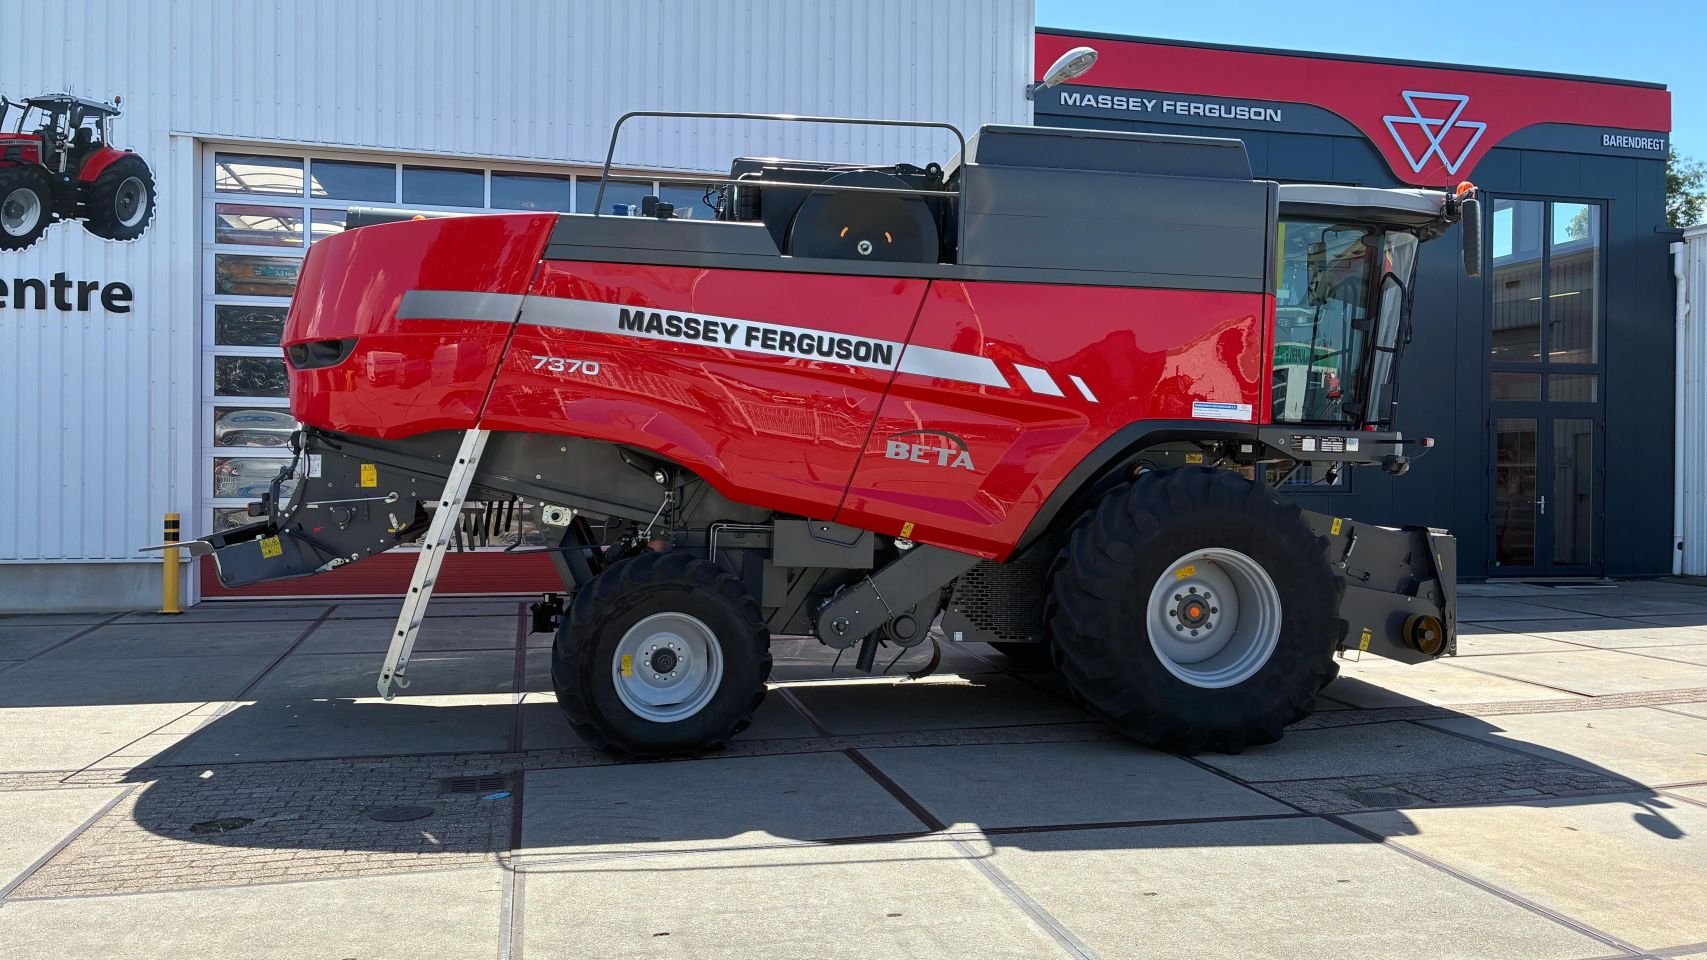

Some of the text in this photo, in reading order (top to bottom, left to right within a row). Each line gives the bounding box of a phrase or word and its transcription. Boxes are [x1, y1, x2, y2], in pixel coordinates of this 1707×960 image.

[1060, 92, 1281, 122] MASSEY FERGUSON
[1603, 134, 1665, 151] BARENDREGT
[0, 272, 133, 313] ntre
[618, 308, 893, 365] MASSEY FERGUSON
[531, 355, 599, 376] 7370
[885, 440, 975, 470] BETA
